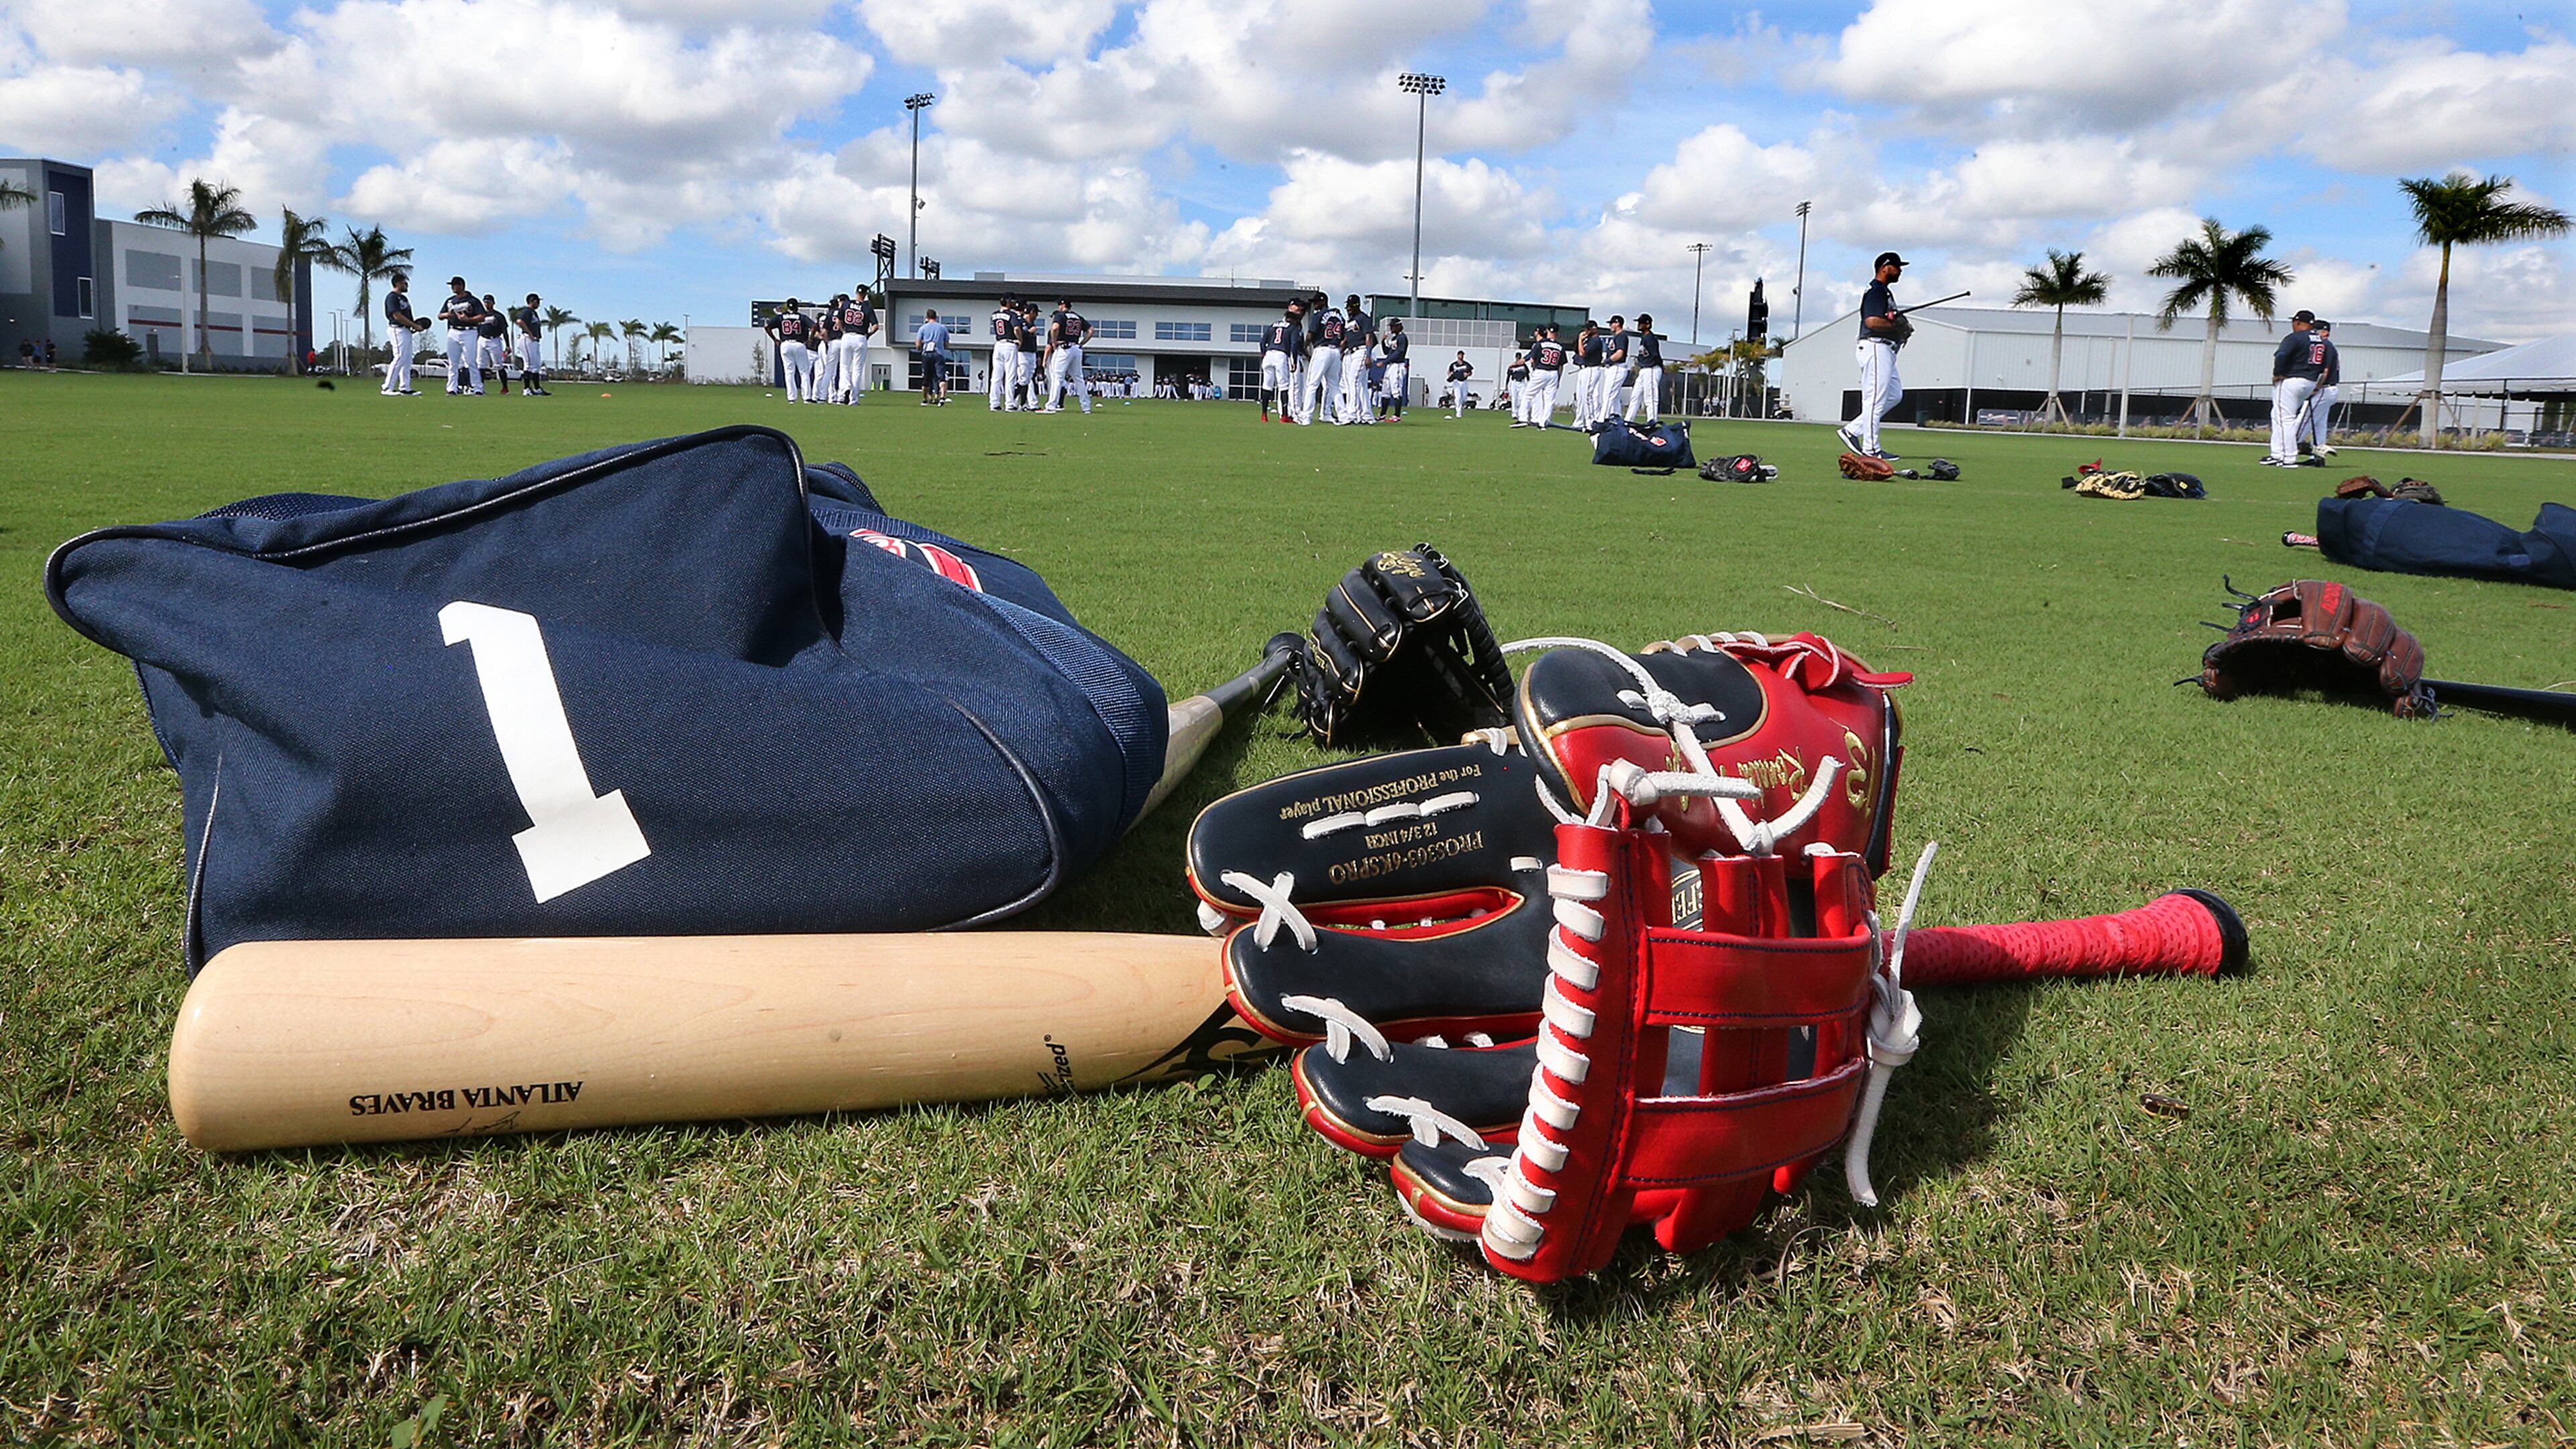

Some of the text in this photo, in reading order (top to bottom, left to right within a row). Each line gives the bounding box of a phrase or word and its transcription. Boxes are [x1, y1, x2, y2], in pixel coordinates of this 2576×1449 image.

[845, 309, 864, 325] 82
[782, 320, 802, 335] 84
[1065, 319, 1082, 336] 23
[1274, 327, 1283, 344] 1
[1324, 322, 1342, 339] 24
[1540, 348, 1560, 366] 38
[2308, 343, 2326, 364] 16
[437, 600, 652, 904] 1
[1279, 763, 1483, 820] For the PROFESSIONAL player
[1364, 821, 1438, 849] 12 3/4 INCH
[348, 1081, 584, 1116] ATLANTA BRAVES
